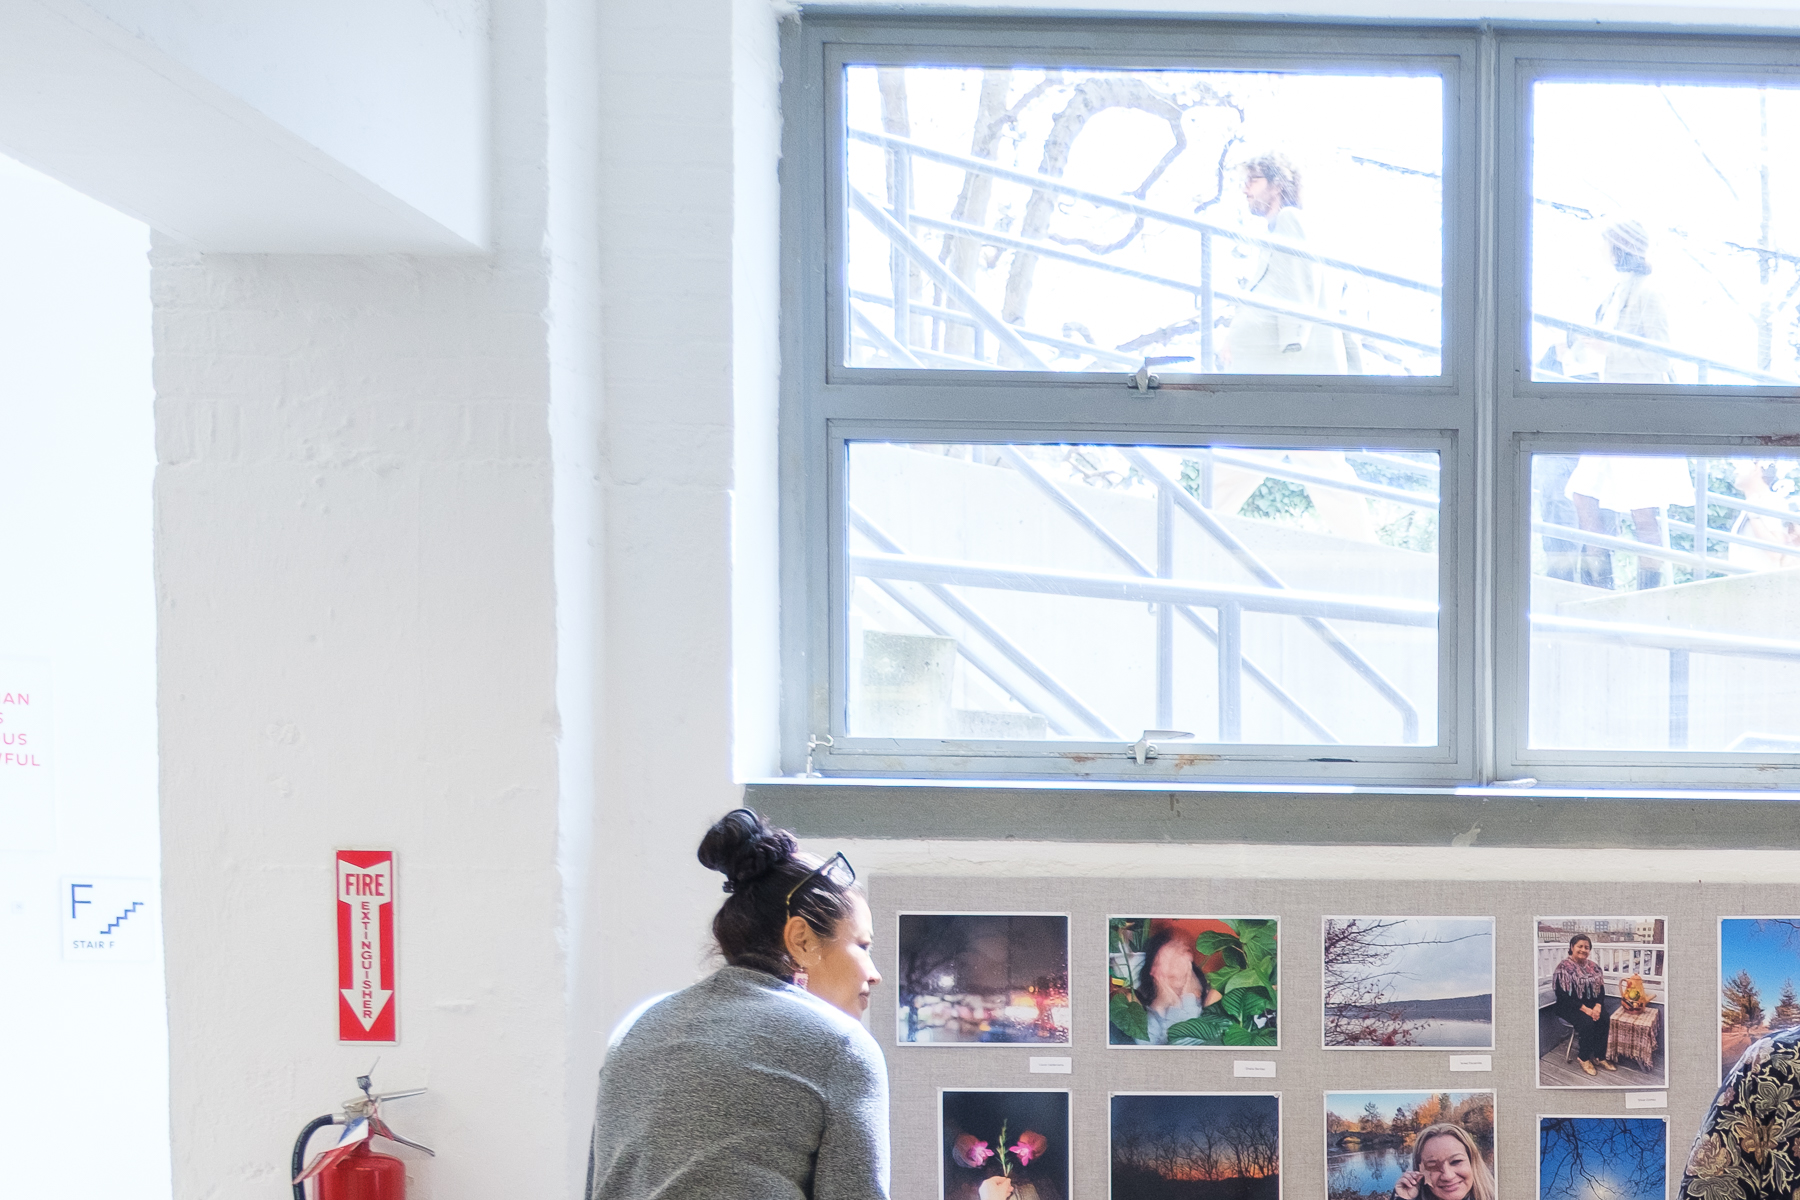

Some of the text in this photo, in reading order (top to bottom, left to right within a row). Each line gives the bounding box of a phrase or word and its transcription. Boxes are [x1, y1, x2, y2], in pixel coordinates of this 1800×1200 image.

[0, 692, 30, 706] AN
[0, 733, 28, 746] US
[345, 873, 386, 897] FIRE
[71, 883, 93, 919] F
[72, 940, 116, 949] STAIR F
[361, 901, 373, 1020] EXTINGUISHER
